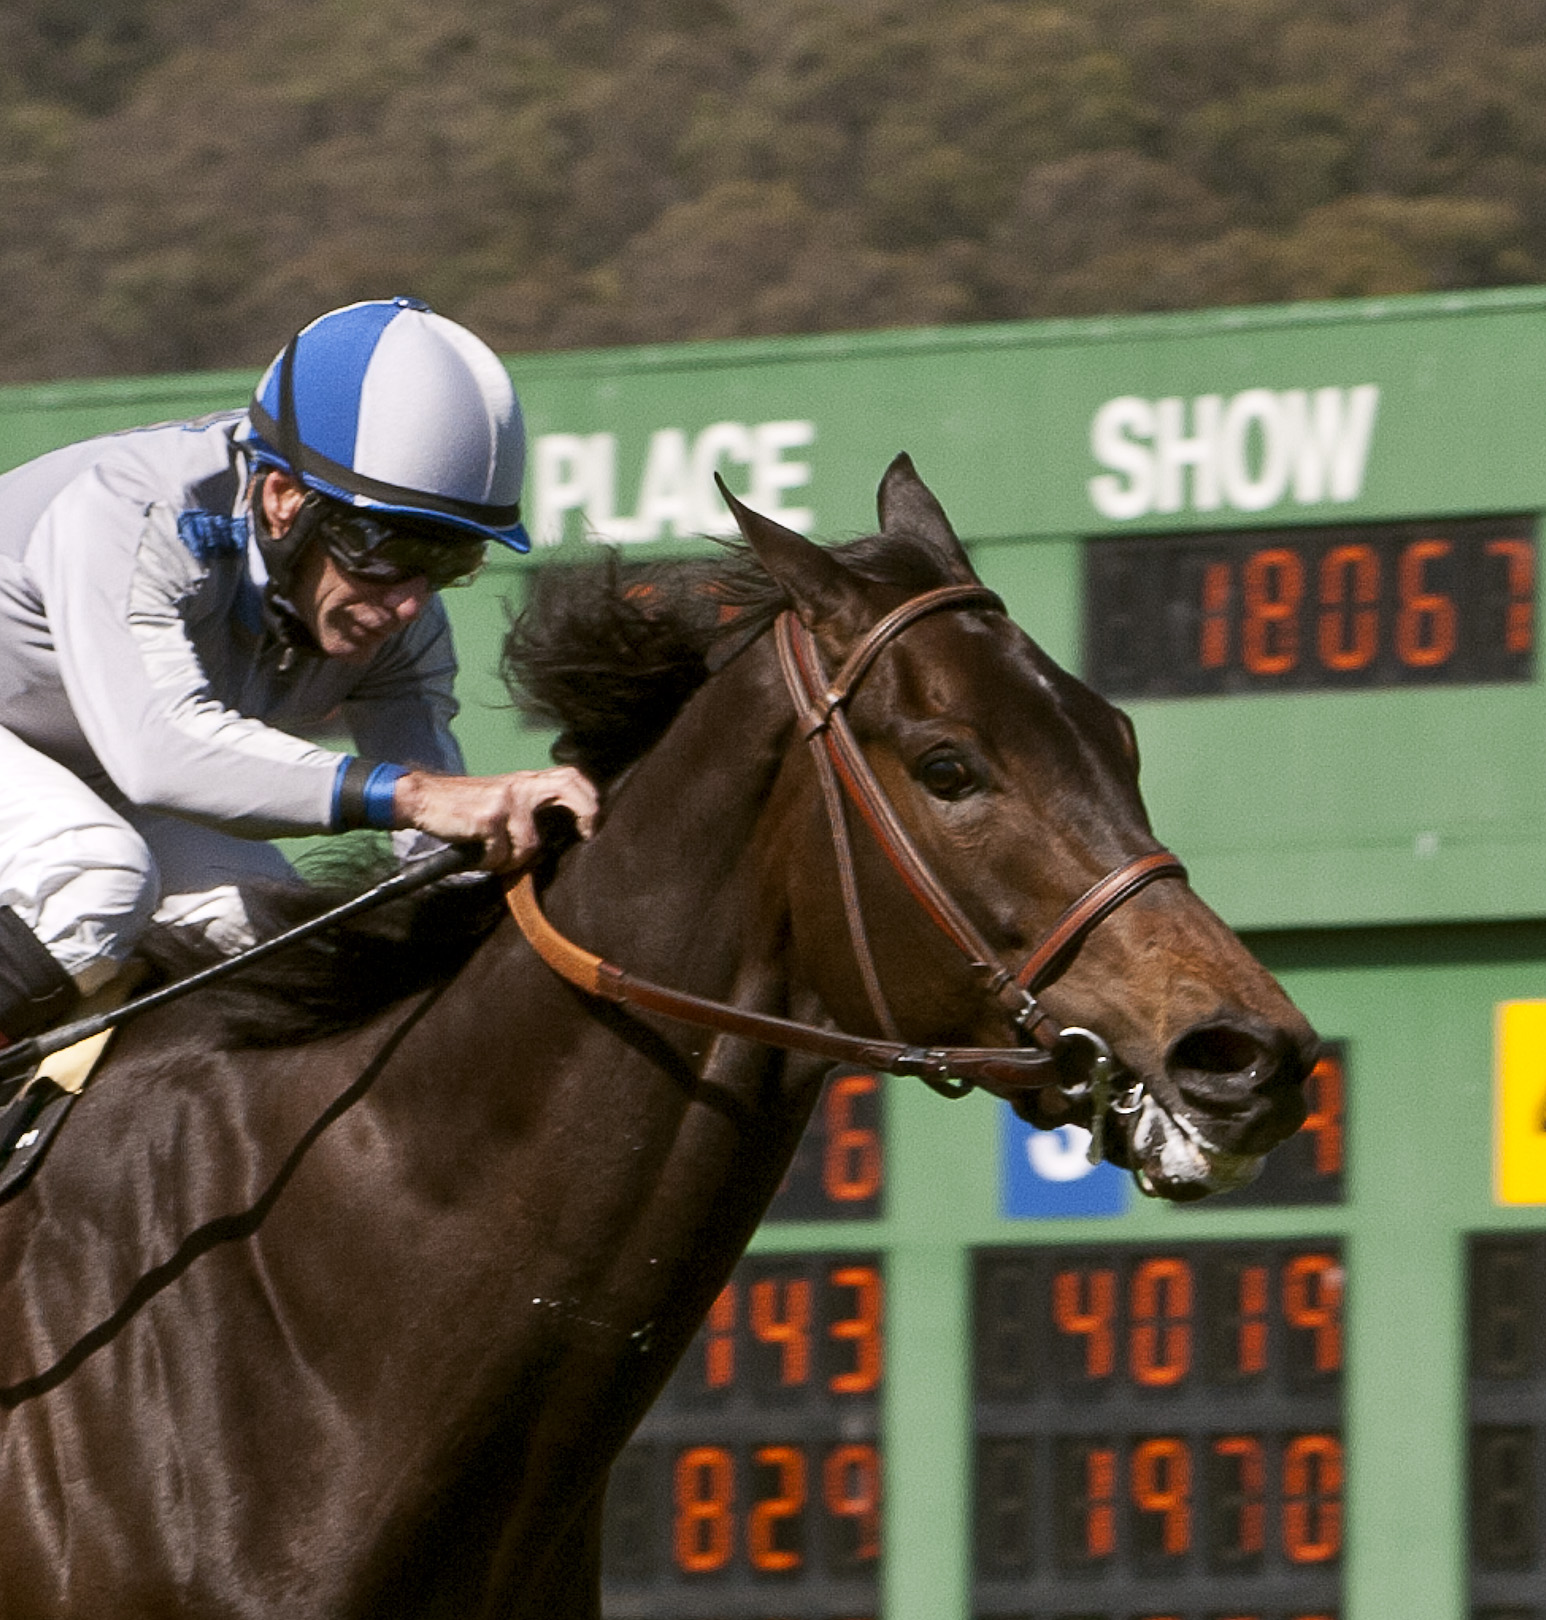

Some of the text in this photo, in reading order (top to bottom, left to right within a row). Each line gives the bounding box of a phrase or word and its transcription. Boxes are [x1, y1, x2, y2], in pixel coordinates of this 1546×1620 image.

[532, 419, 815, 546] PLACE
[1088, 384, 1380, 520] SHOW
[1199, 537, 1535, 676] 18067
[1052, 1255, 1344, 1388] 4019
[673, 1444, 882, 1574] 829
[1085, 1433, 1344, 1564] 1970
